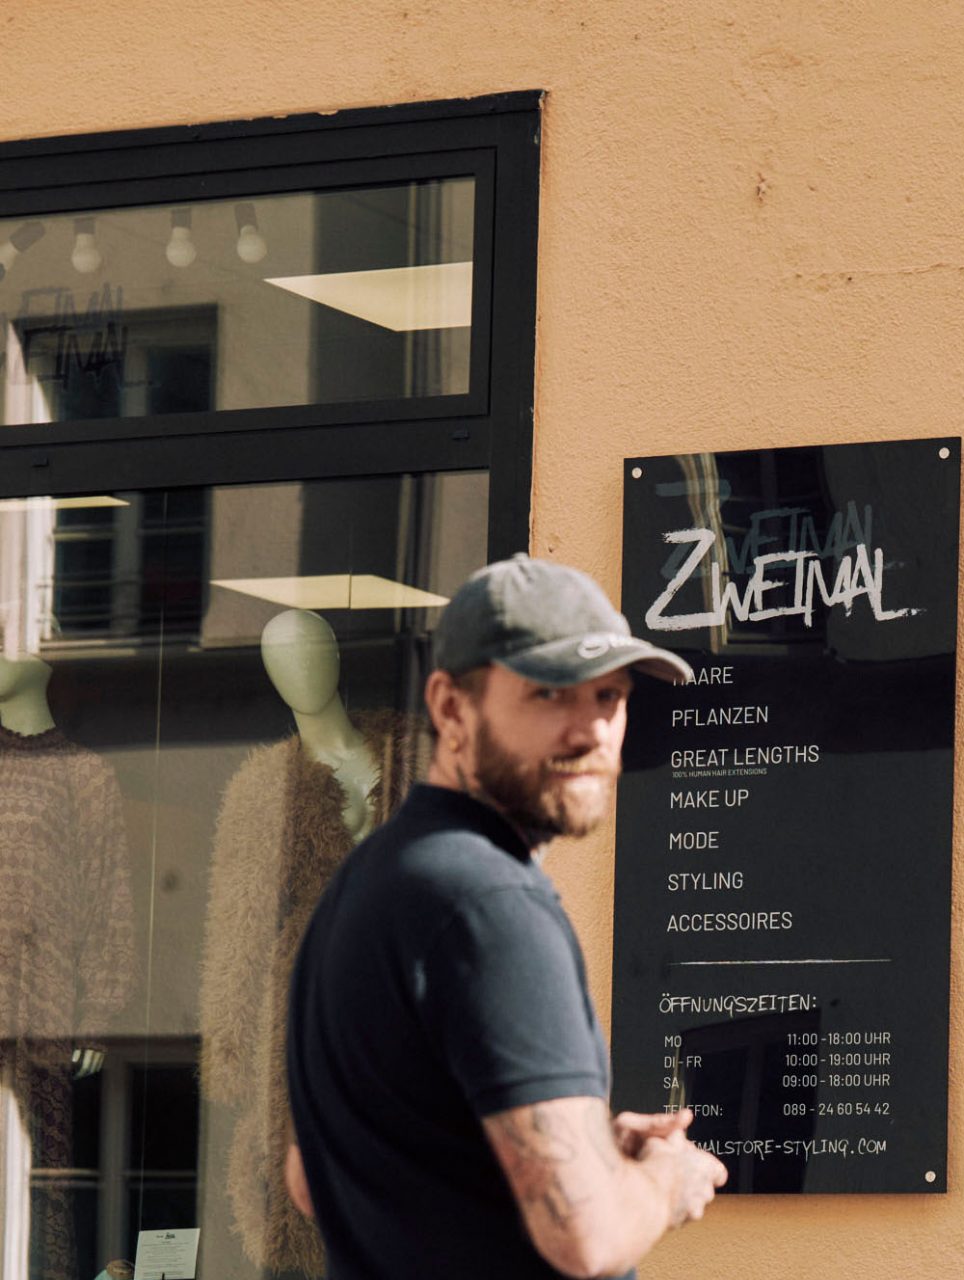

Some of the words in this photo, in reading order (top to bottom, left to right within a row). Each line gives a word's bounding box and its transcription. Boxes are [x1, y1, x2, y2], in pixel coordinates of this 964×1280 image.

[645, 527, 926, 631] ZWEIMAL
[672, 706, 769, 727] PFLANZEN
[671, 749, 729, 768] GREAT
[733, 745, 820, 766] LENGTHS
[689, 770, 711, 778] HUMAN
[712, 769, 726, 777] HAIR
[728, 767, 768, 777] EXTENSIONS
[670, 790, 719, 808] MAKE
[725, 789, 749, 807] UP
[669, 831, 720, 850] MODE
[668, 872, 744, 891] STYLING
[667, 912, 793, 932] ACCESSOIRES
[659, 992, 817, 1017] ÖFFNUNGSZEITEN:
[664, 1035, 682, 1048] MO
[787, 1033, 818, 1045] 11:00
[864, 1032, 891, 1045] UHR
[786, 1054, 818, 1066] 10:00
[829, 1053, 861, 1066] 19:00
[864, 1053, 891, 1066] UHR
[663, 1077, 679, 1089] SA
[782, 1075, 818, 1088] 09:00
[829, 1074, 861, 1087] 18:00
[863, 1074, 891, 1087] UHR
[783, 1103, 806, 1116] 089
[818, 1103, 834, 1116] 24
[837, 1103, 853, 1116] 60
[855, 1103, 871, 1116] 54
[874, 1102, 890, 1115] 42
